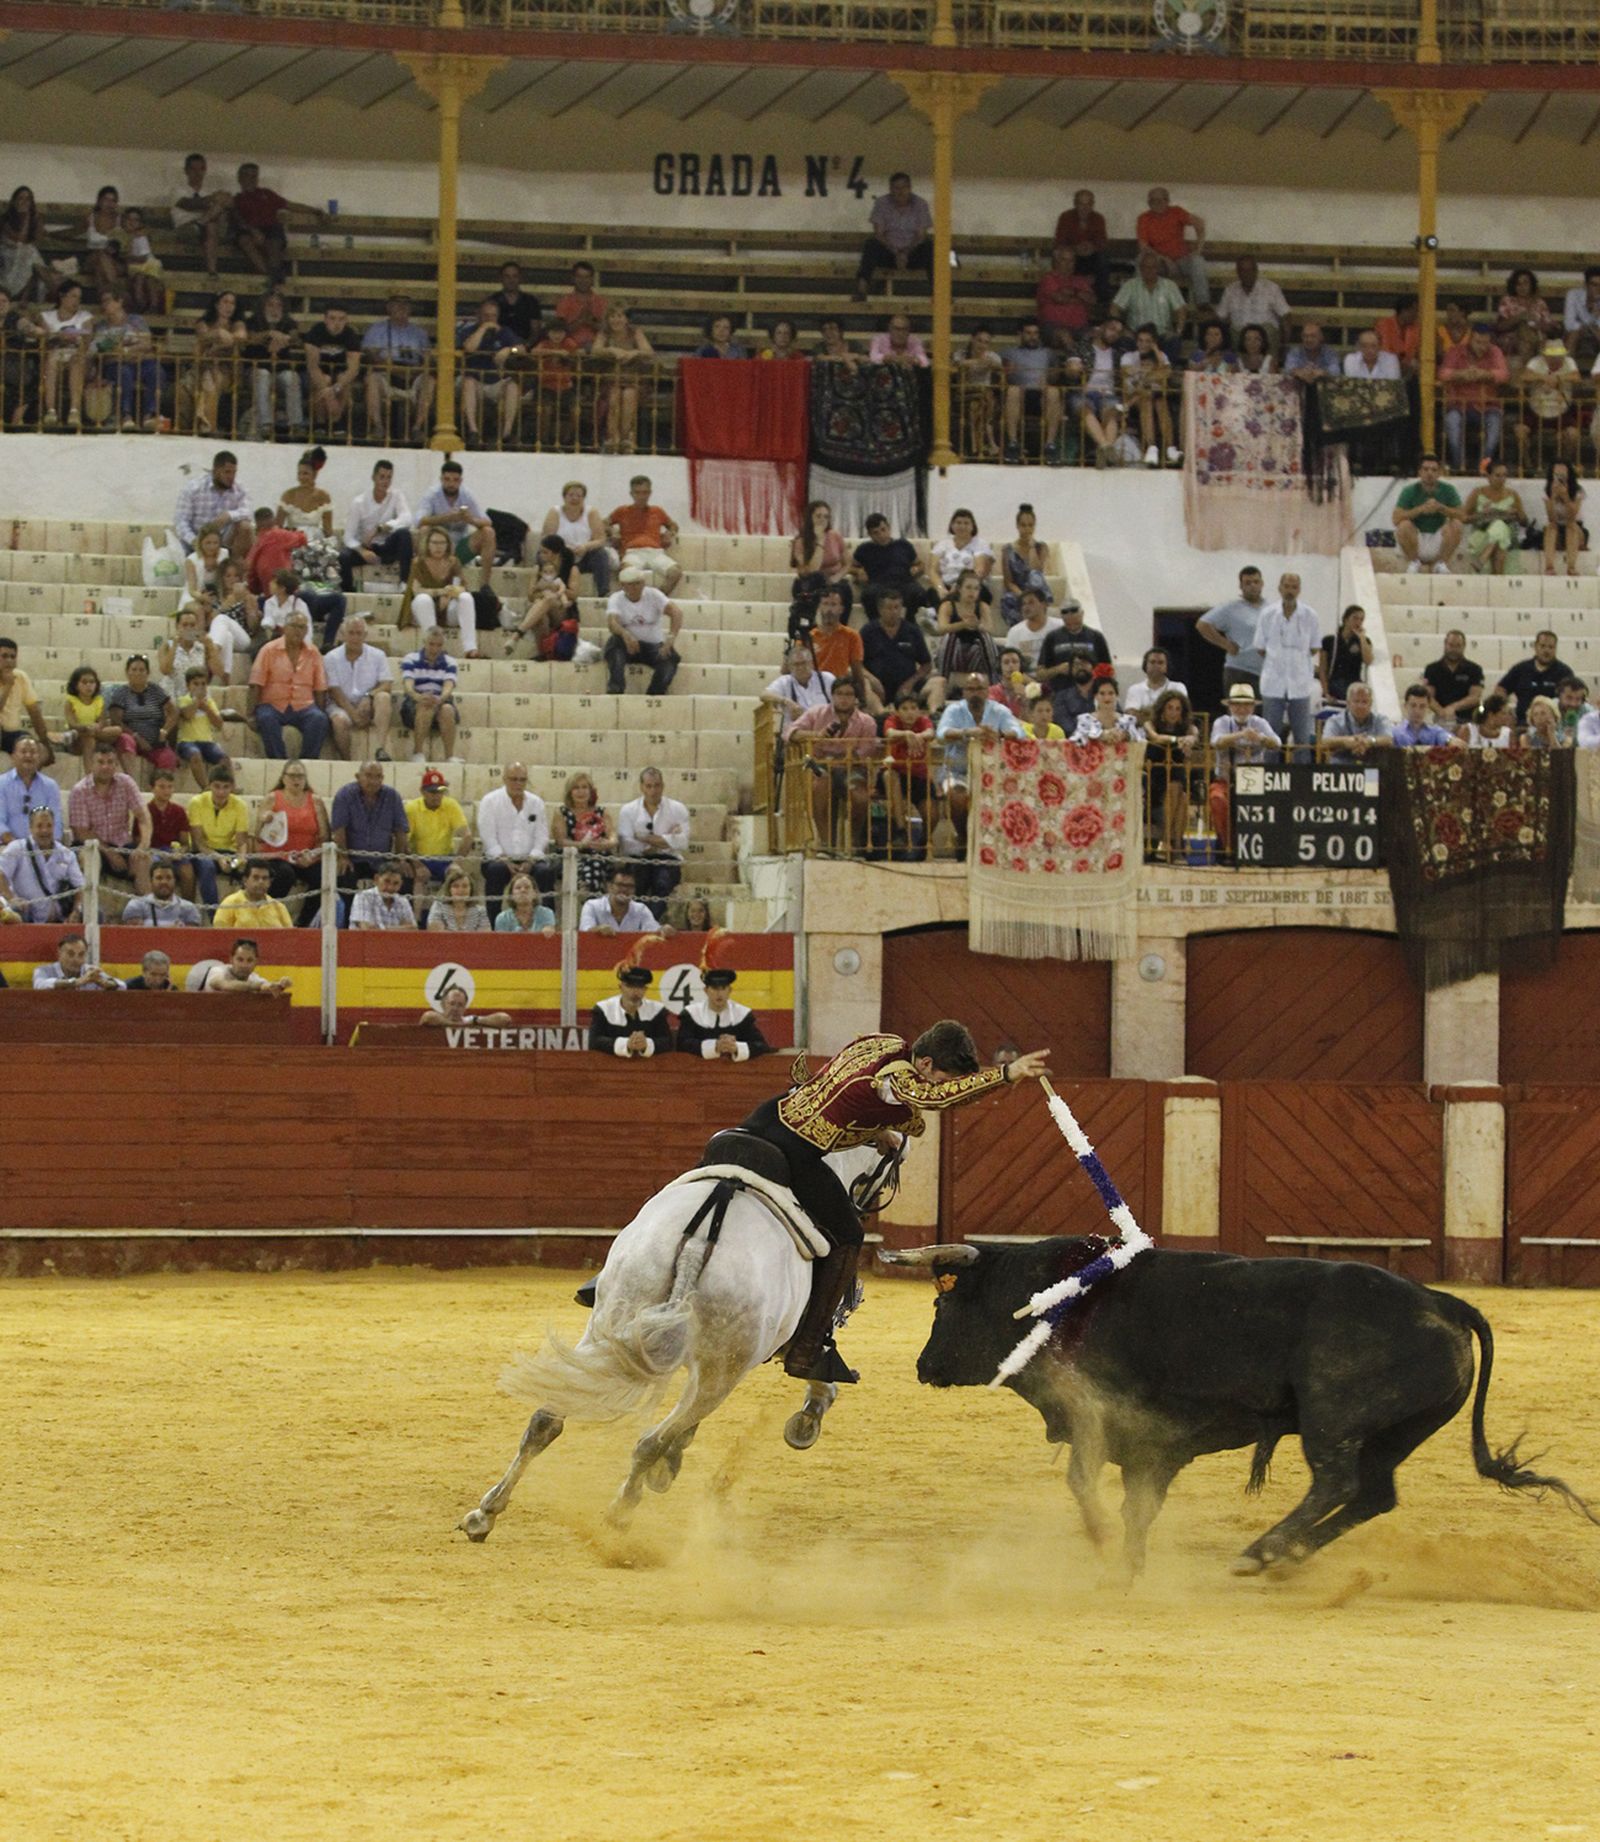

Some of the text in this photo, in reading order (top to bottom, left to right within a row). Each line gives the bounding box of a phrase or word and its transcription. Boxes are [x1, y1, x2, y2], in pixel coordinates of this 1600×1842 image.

[654, 153, 781, 196] GRADA
[1265, 771, 1291, 791] SAN
[1312, 772, 1364, 792] PELAYO
[1236, 805, 1275, 823] N31
[1237, 833, 1373, 861] KG 500
[1157, 887, 1174, 902] EL
[1200, 888, 1218, 904] DE
[1226, 889, 1310, 905] SEPTIEMBRE
[1315, 889, 1334, 905] DE
[668, 969, 694, 1007] 4
